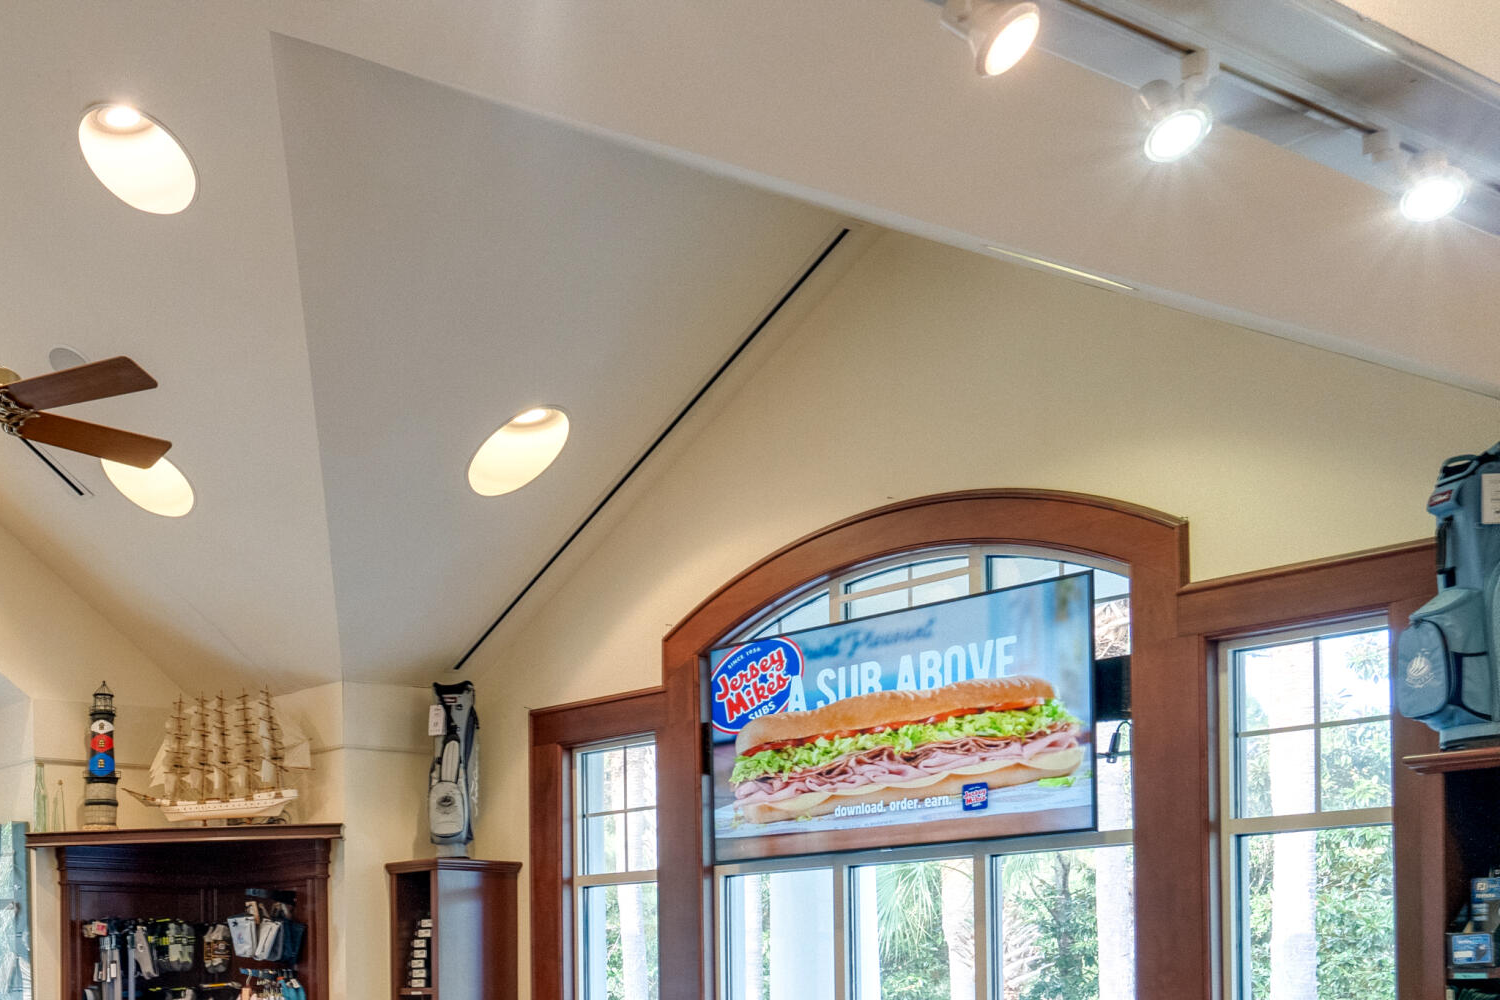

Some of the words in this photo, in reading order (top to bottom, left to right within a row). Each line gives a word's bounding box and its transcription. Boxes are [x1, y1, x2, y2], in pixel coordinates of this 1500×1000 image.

[728, 654, 744, 669] SINCE
[715, 647, 787, 702] Jersey
[788, 674, 808, 712] A
[816, 660, 882, 708] SUB
[896, 635, 1018, 692] ABOVE
[748, 701, 776, 720] SUBS
[834, 800, 887, 818] download.
[889, 798, 922, 811] order.
[924, 795, 952, 808] earn.
